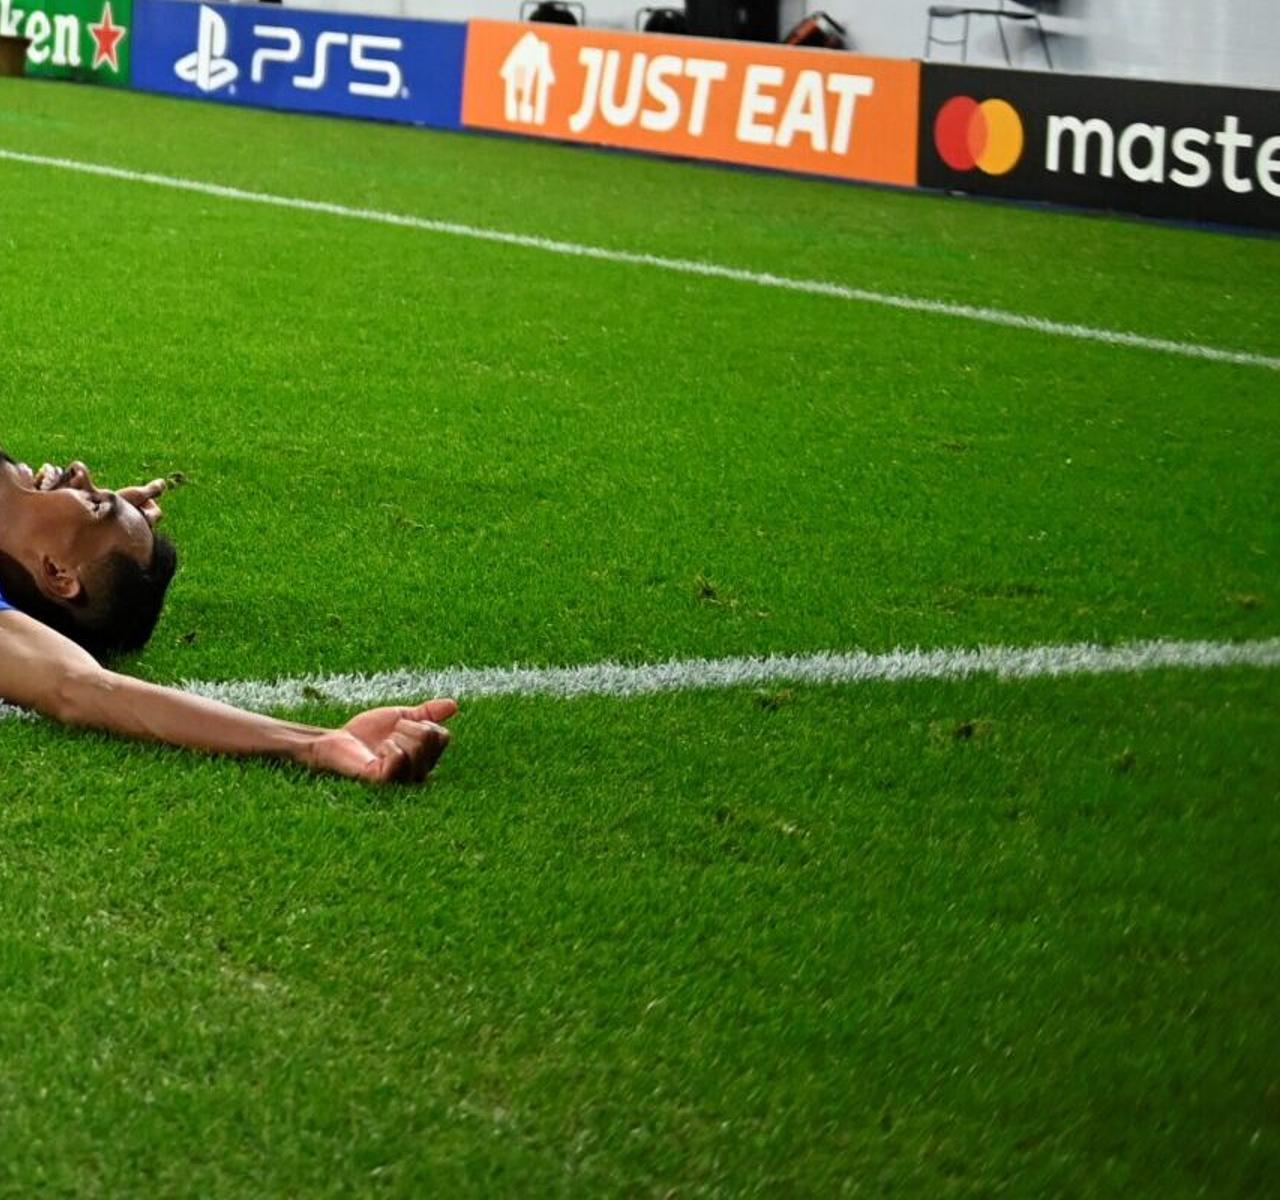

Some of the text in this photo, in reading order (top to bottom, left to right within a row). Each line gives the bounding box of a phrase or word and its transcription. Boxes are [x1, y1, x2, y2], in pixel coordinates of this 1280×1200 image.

[251, 24, 404, 99] PS5
[569, 46, 874, 156] JUST EAT
